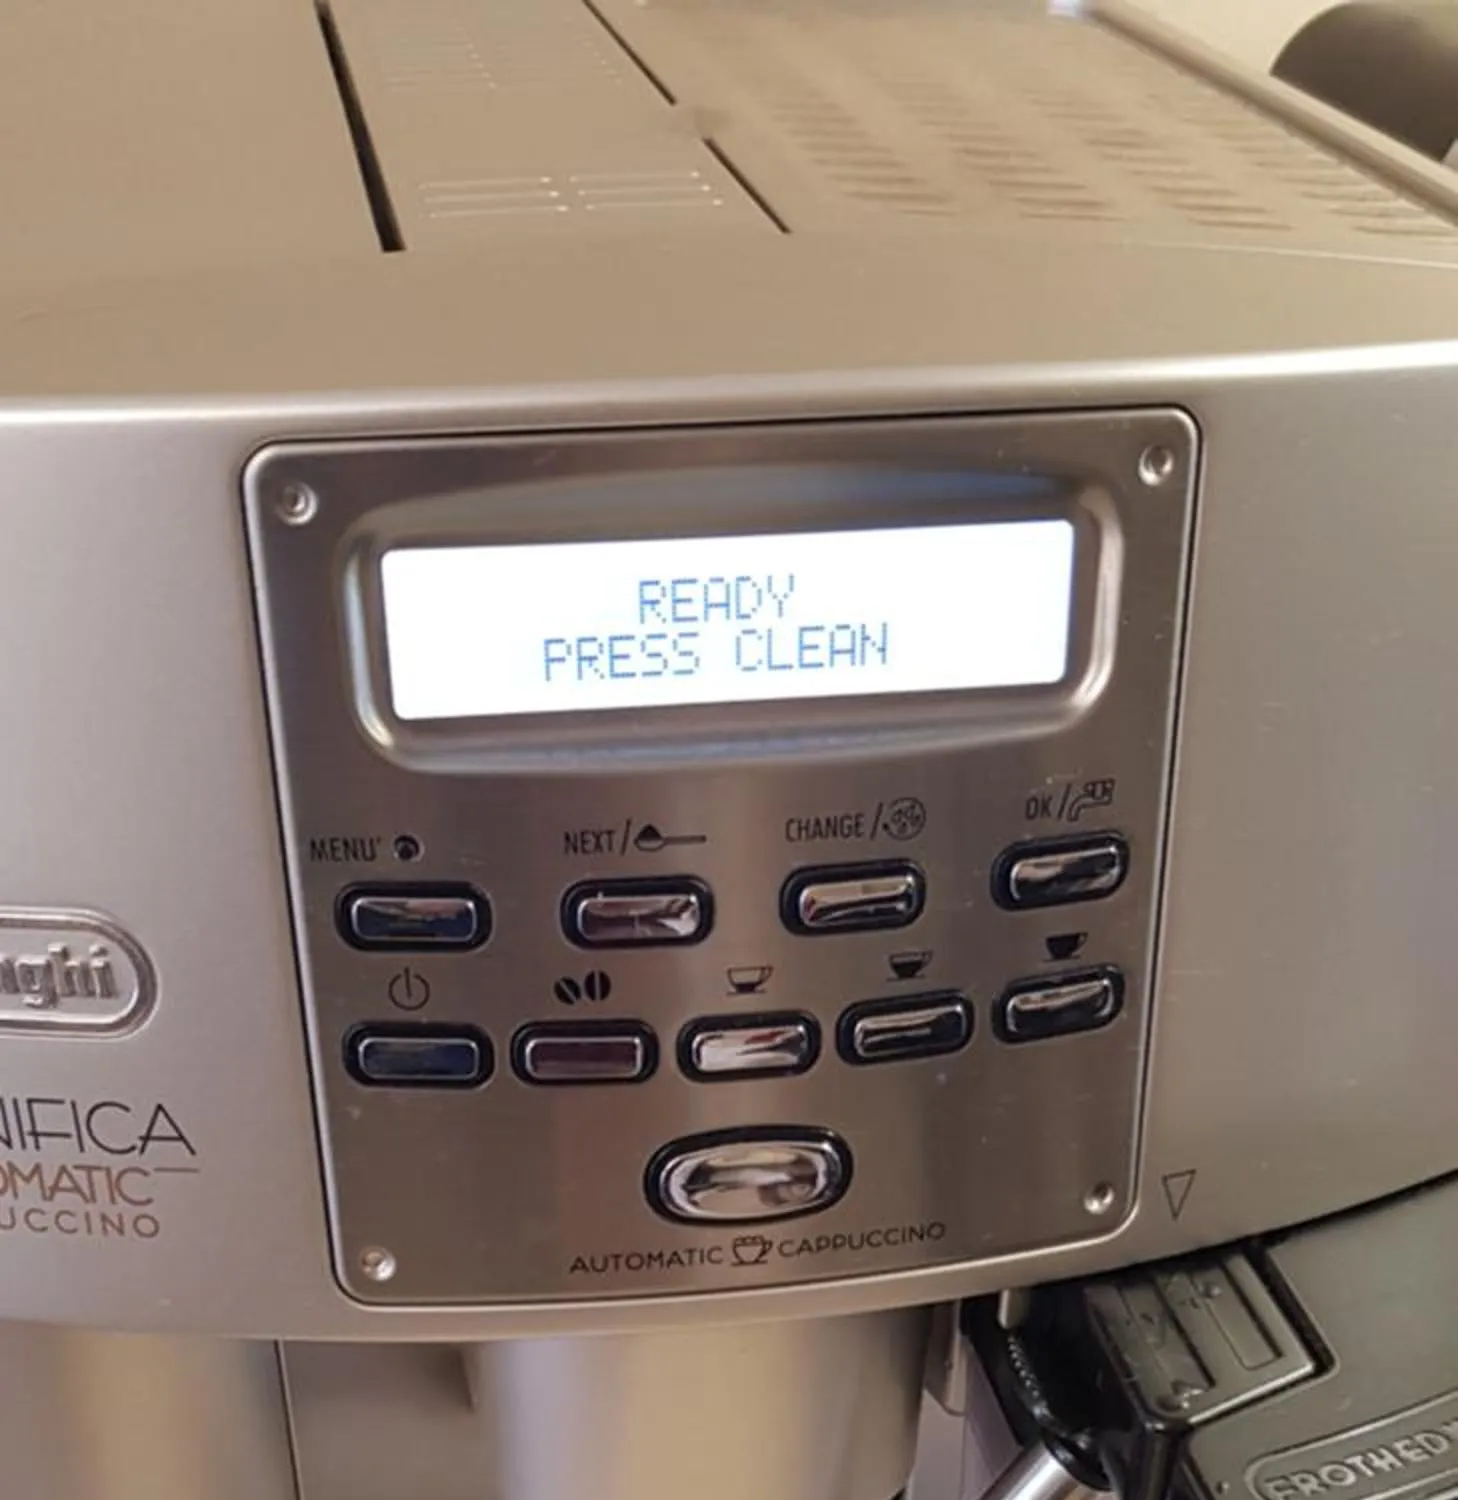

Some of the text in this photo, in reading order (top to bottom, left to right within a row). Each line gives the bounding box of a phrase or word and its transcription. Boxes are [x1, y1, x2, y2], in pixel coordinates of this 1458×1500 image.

[637, 573, 796, 626] READY
[543, 621, 889, 682] PRESS CLEAN
[0, 1161, 155, 1207] MATIC
[568, 1221, 947, 1275] AUTOMATIC CAPPUCCINO
